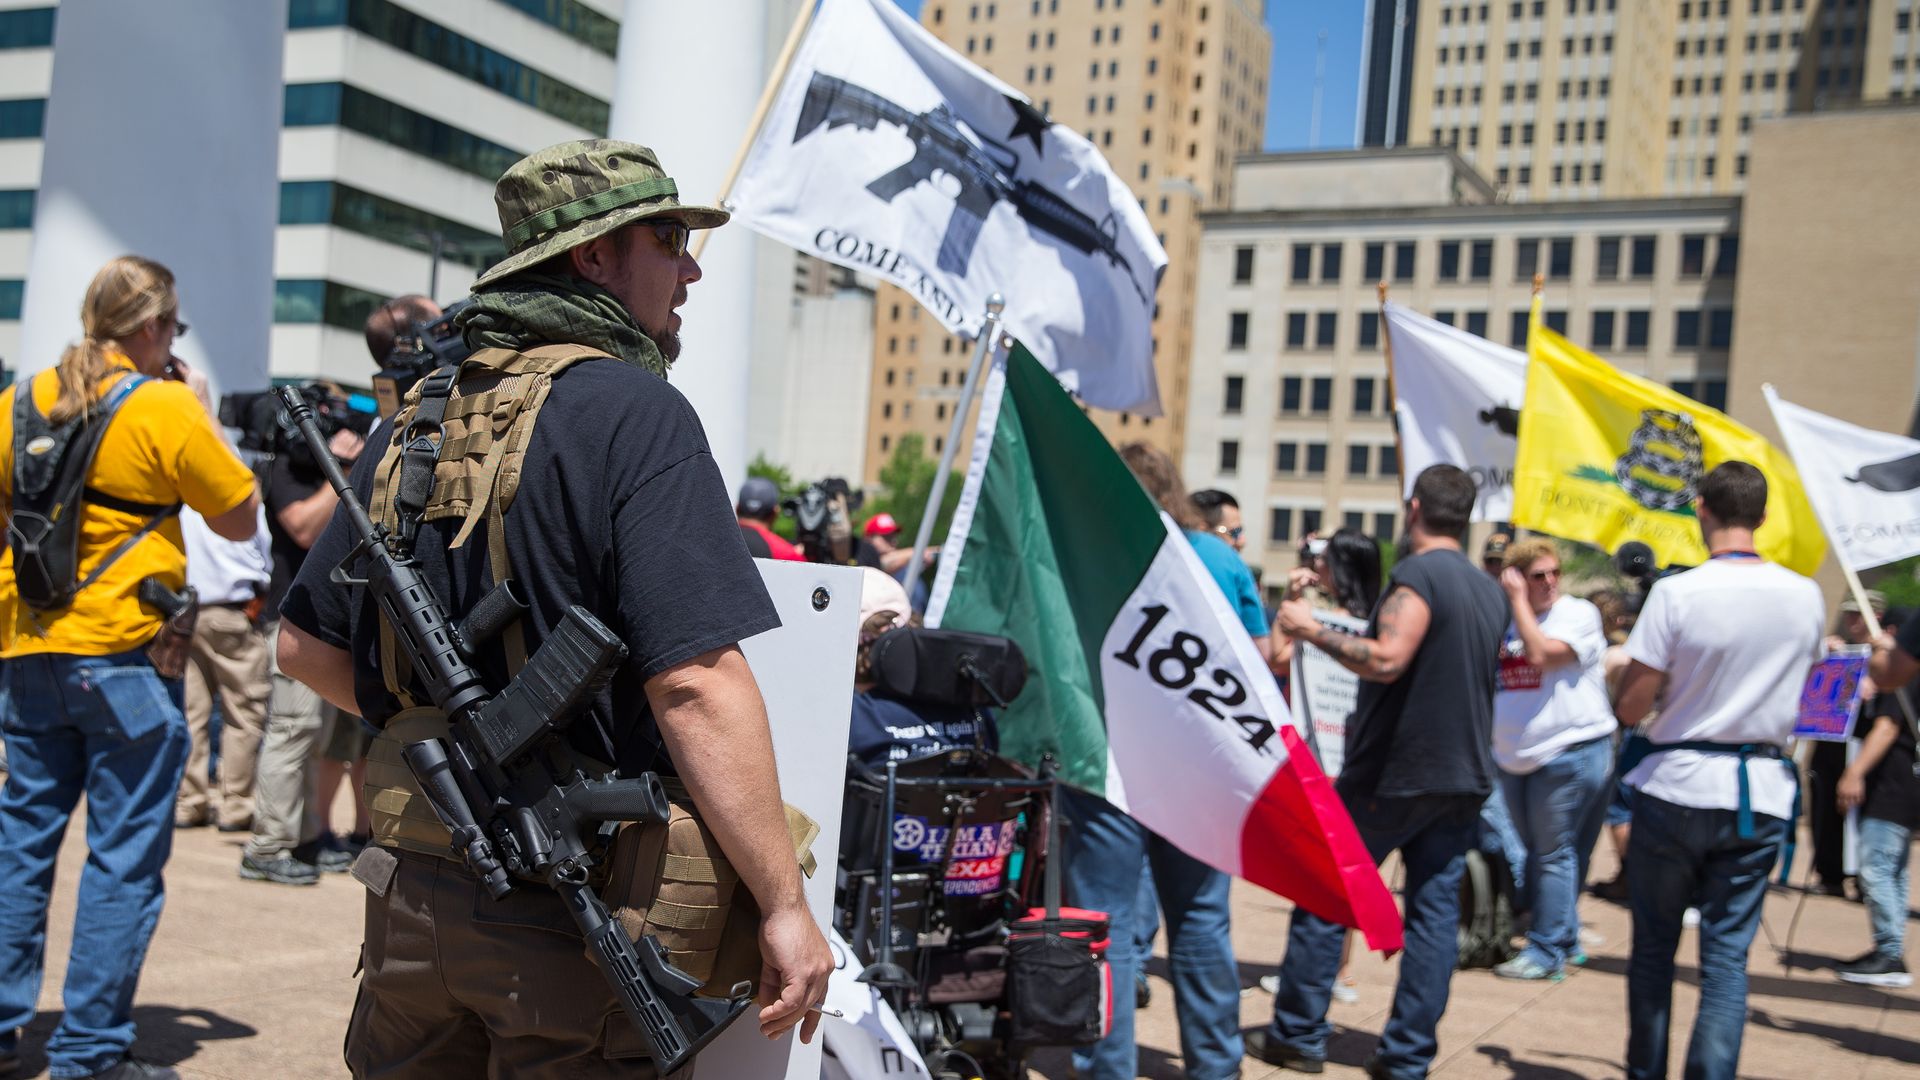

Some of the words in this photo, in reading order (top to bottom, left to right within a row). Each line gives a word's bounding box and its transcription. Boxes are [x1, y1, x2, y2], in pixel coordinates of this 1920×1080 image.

[814, 227, 907, 279] COME
[912, 274, 964, 325] AND
[1466, 465, 1514, 489] OM
[1114, 604, 1276, 757] 1824
[945, 858, 1002, 877] EXAS
